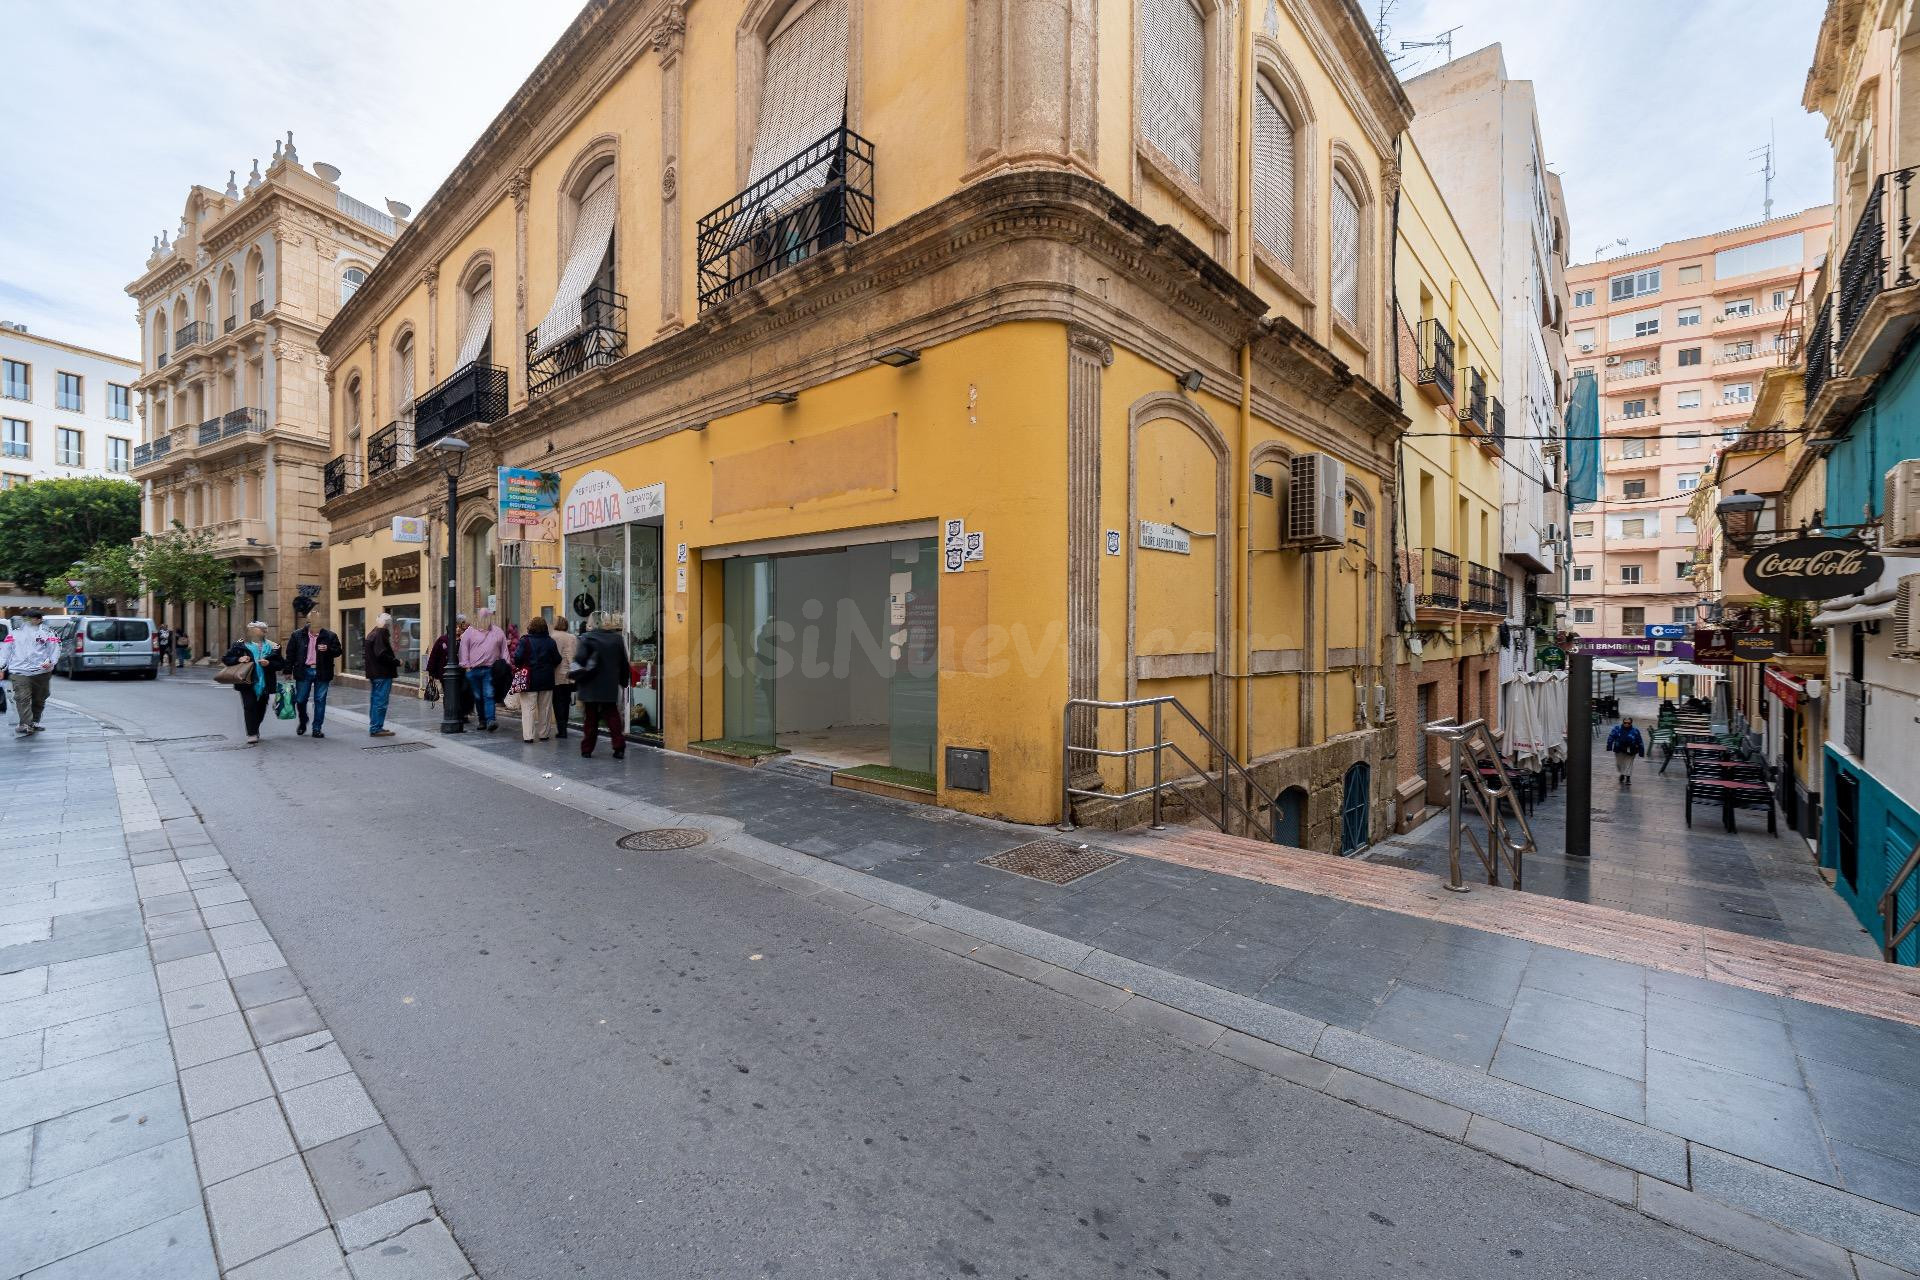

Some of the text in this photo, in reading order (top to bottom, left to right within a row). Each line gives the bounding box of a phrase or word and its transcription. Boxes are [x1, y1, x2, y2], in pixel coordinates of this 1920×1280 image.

[566, 493, 621, 531] FLORANA
[1142, 535, 1188, 551] PADRE ALFONSO TORRES
[1755, 549, 1866, 578] Coca-Cola
